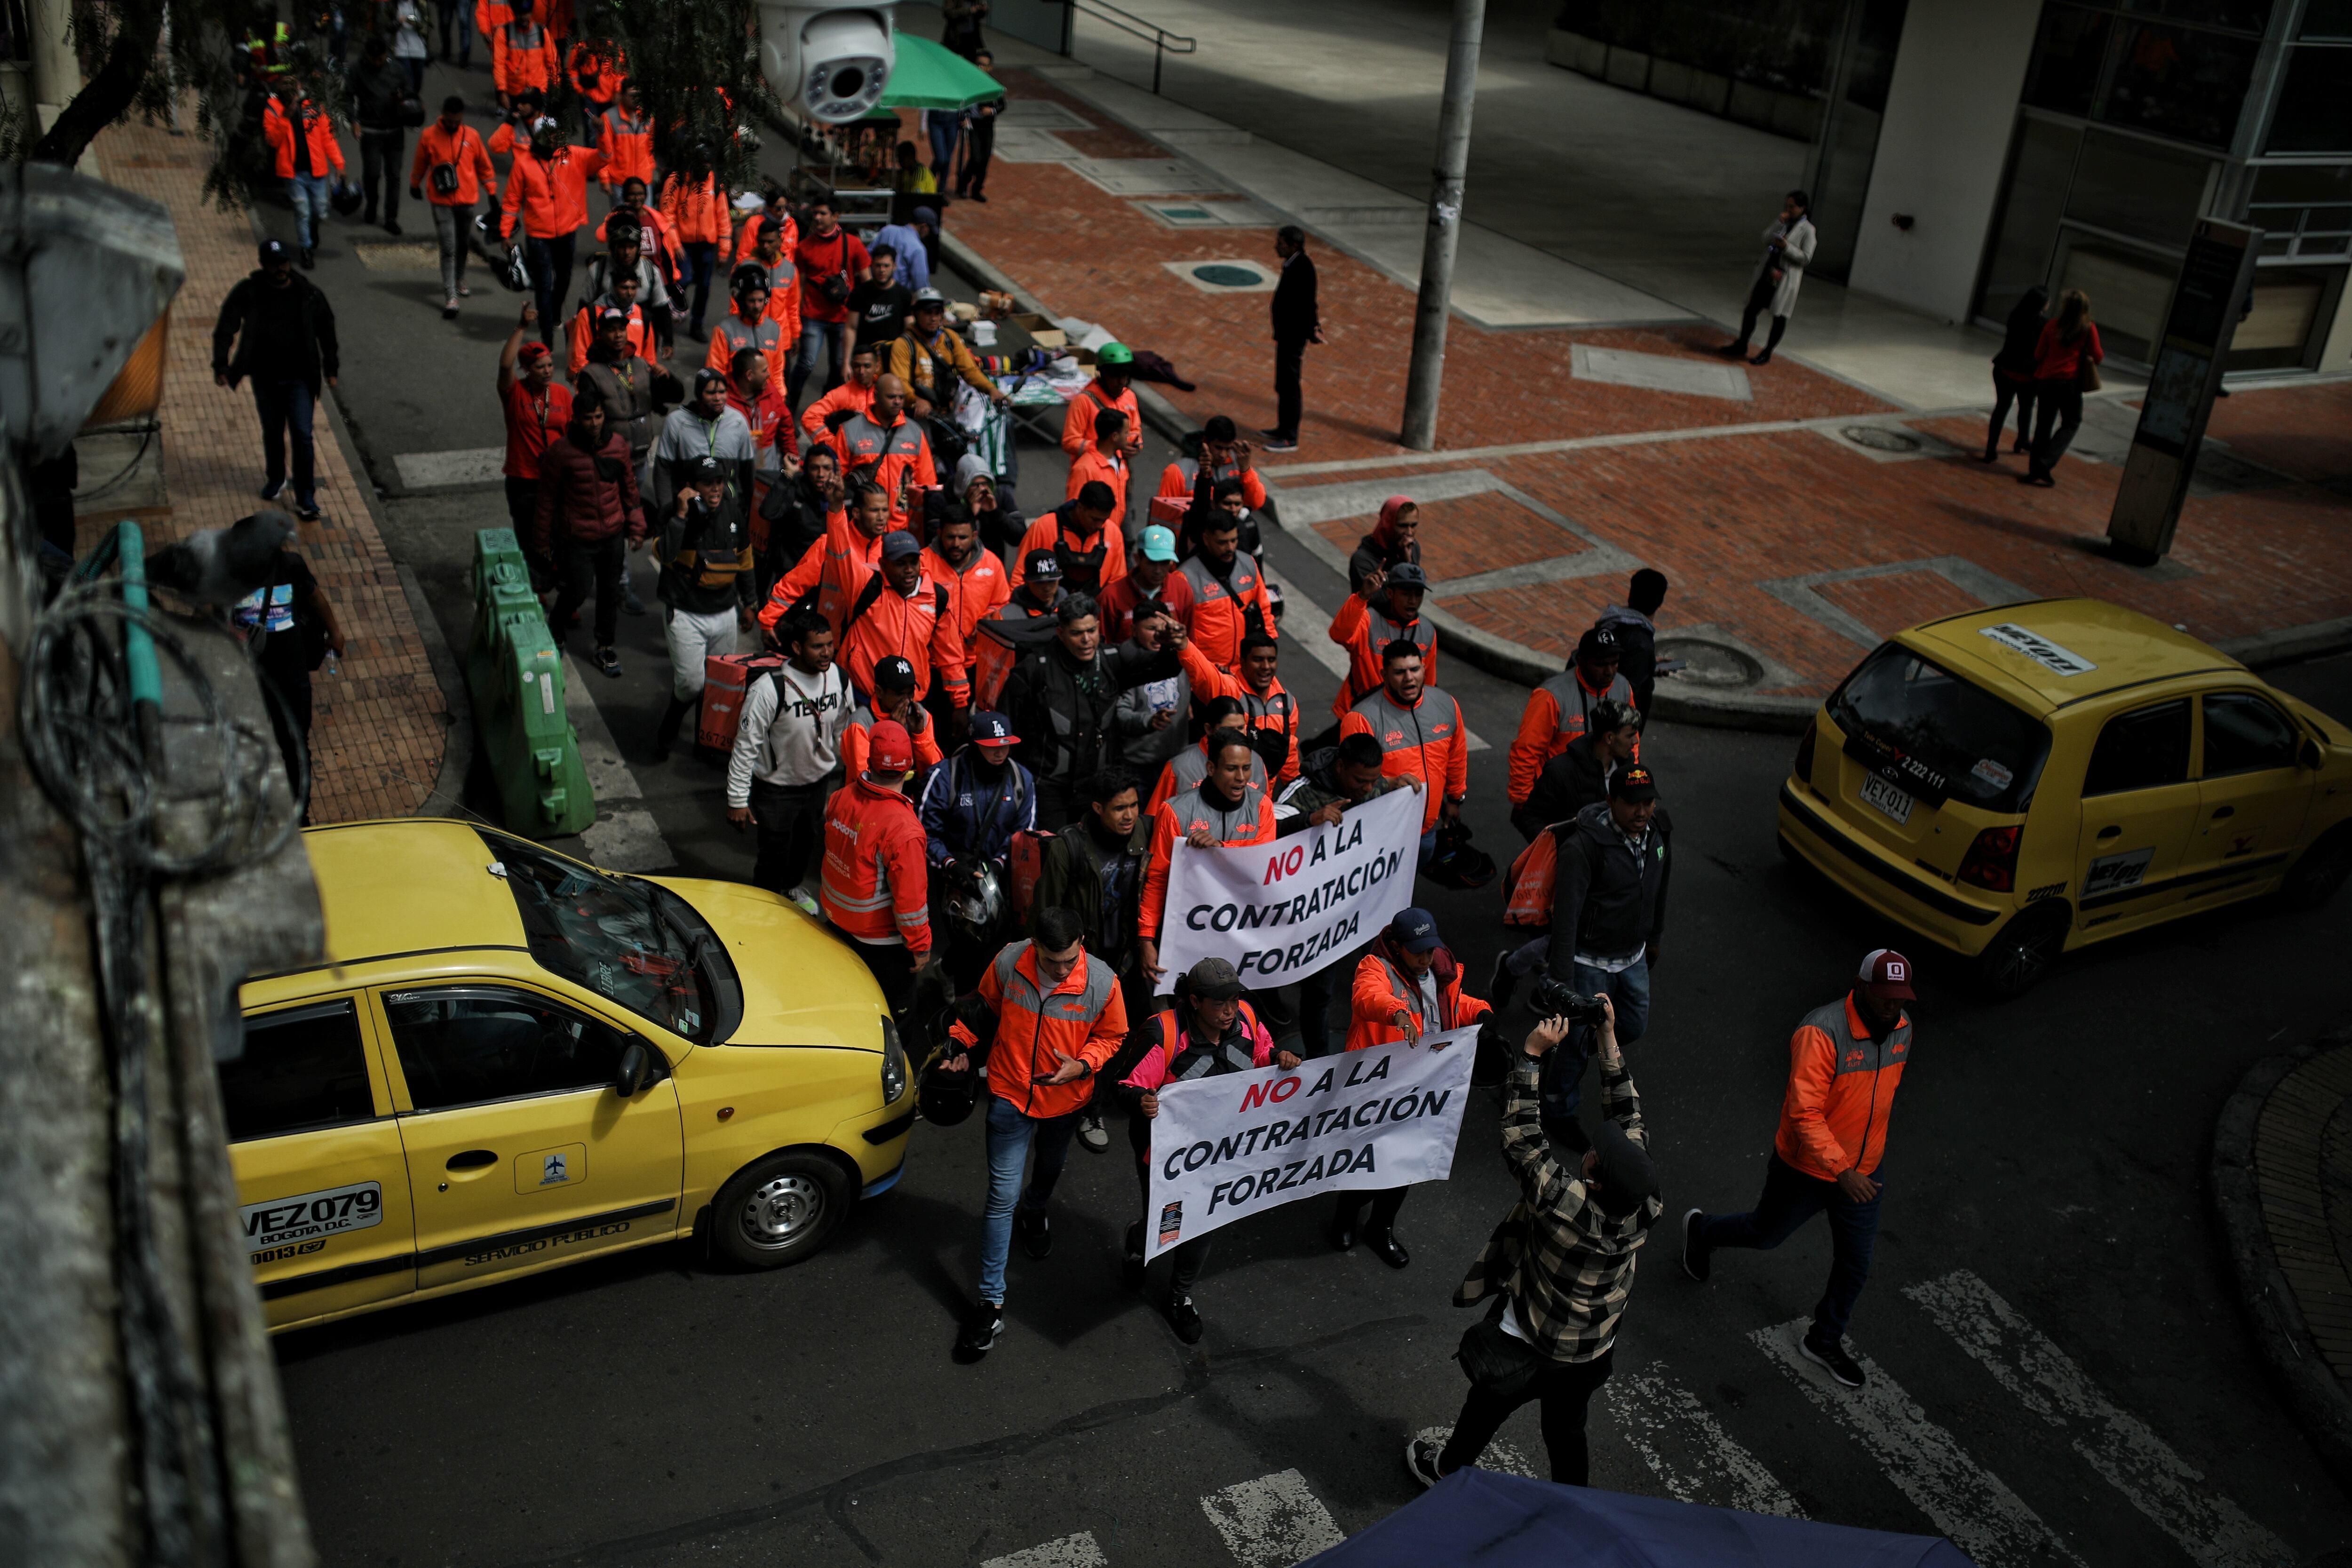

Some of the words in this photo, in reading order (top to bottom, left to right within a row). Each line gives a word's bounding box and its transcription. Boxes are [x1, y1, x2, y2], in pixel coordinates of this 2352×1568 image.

[869, 303, 896, 315] NIKE
[992, 720, 1006, 737] LA
[1900, 755, 1911, 769] 2
[1908, 760, 1928, 780] 222
[1927, 770, 1946, 789] 111
[1263, 845, 1303, 885] NO
[1310, 835, 1326, 867] A
[1335, 819, 1362, 855] LA
[1186, 847, 1405, 931] CONTRATACIÓN
[1237, 911, 1359, 976] FORZADA
[1239, 1077, 1302, 1113] NO
[1306, 1068, 1335, 1097] A
[1343, 1055, 1391, 1088] LA
[1164, 1087, 1451, 1180] CONTRATACIÓN
[1207, 1143, 1375, 1216] FORZADA
[260, 1225, 321, 1245] BOGOTA
[464, 1240, 547, 1266] SERVICIO
[552, 1222, 630, 1247] PUBLICO
